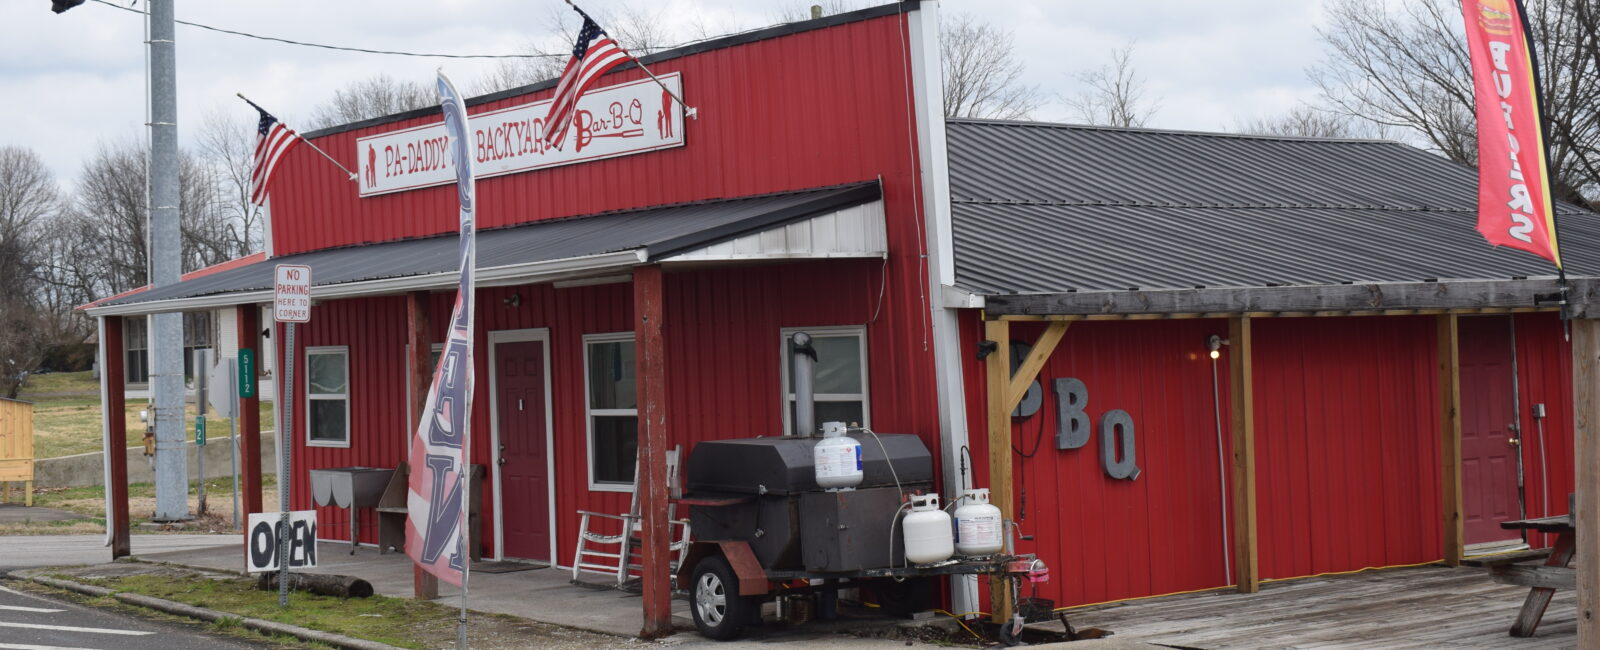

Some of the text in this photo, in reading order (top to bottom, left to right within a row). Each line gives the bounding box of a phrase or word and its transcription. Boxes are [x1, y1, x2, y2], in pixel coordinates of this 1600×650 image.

[385, 135, 455, 178] PA-DADDY
[286, 269, 300, 281] NO
[277, 284, 309, 296] PARKING
[277, 298, 308, 307] HERE TO
[279, 309, 307, 318] CORNER
[196, 428, 202, 441] 2
[250, 519, 317, 569] OPEN
